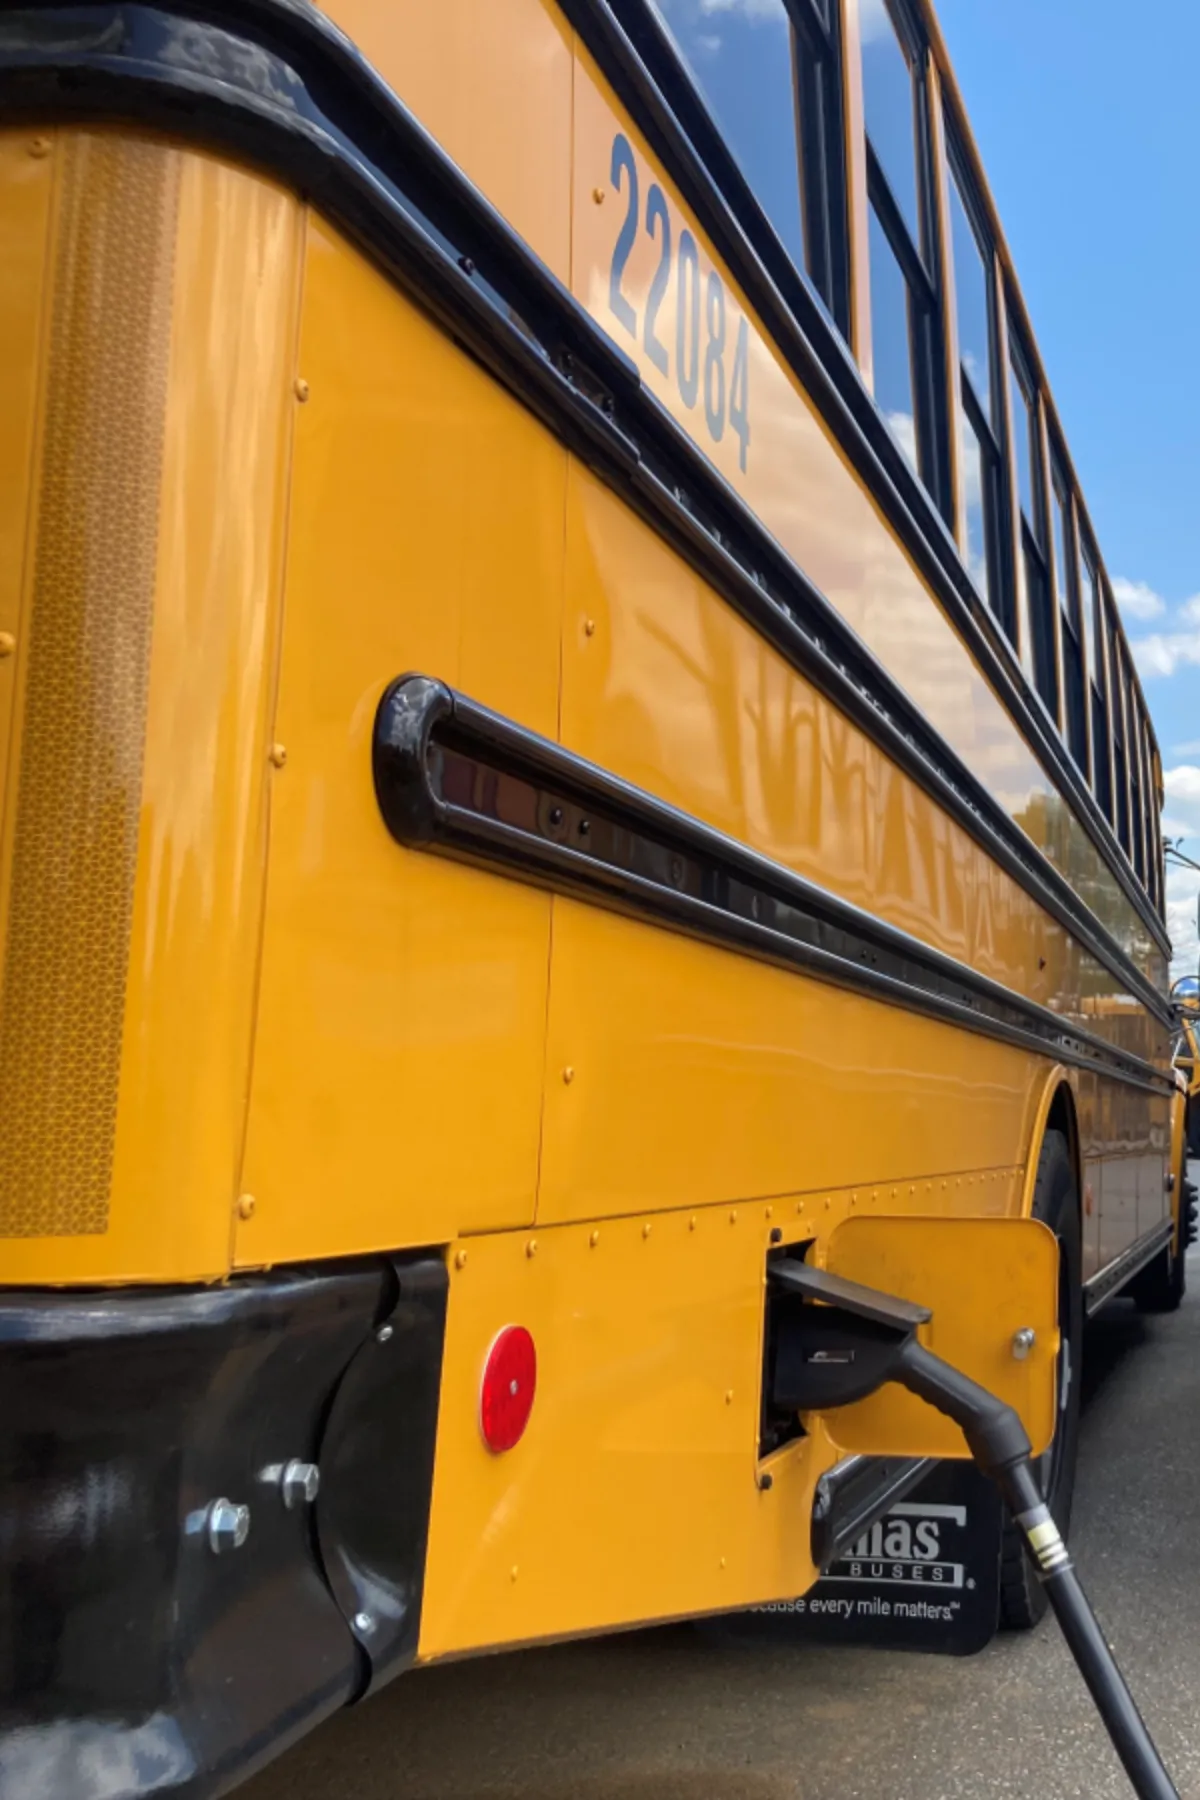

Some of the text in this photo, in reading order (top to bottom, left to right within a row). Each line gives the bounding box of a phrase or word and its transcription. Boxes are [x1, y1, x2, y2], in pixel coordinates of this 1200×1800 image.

[609, 133, 750, 474] 22084
[850, 1563, 943, 1581] BUSES
[809, 1599, 853, 1618] every
[857, 1597, 890, 1615] mile
